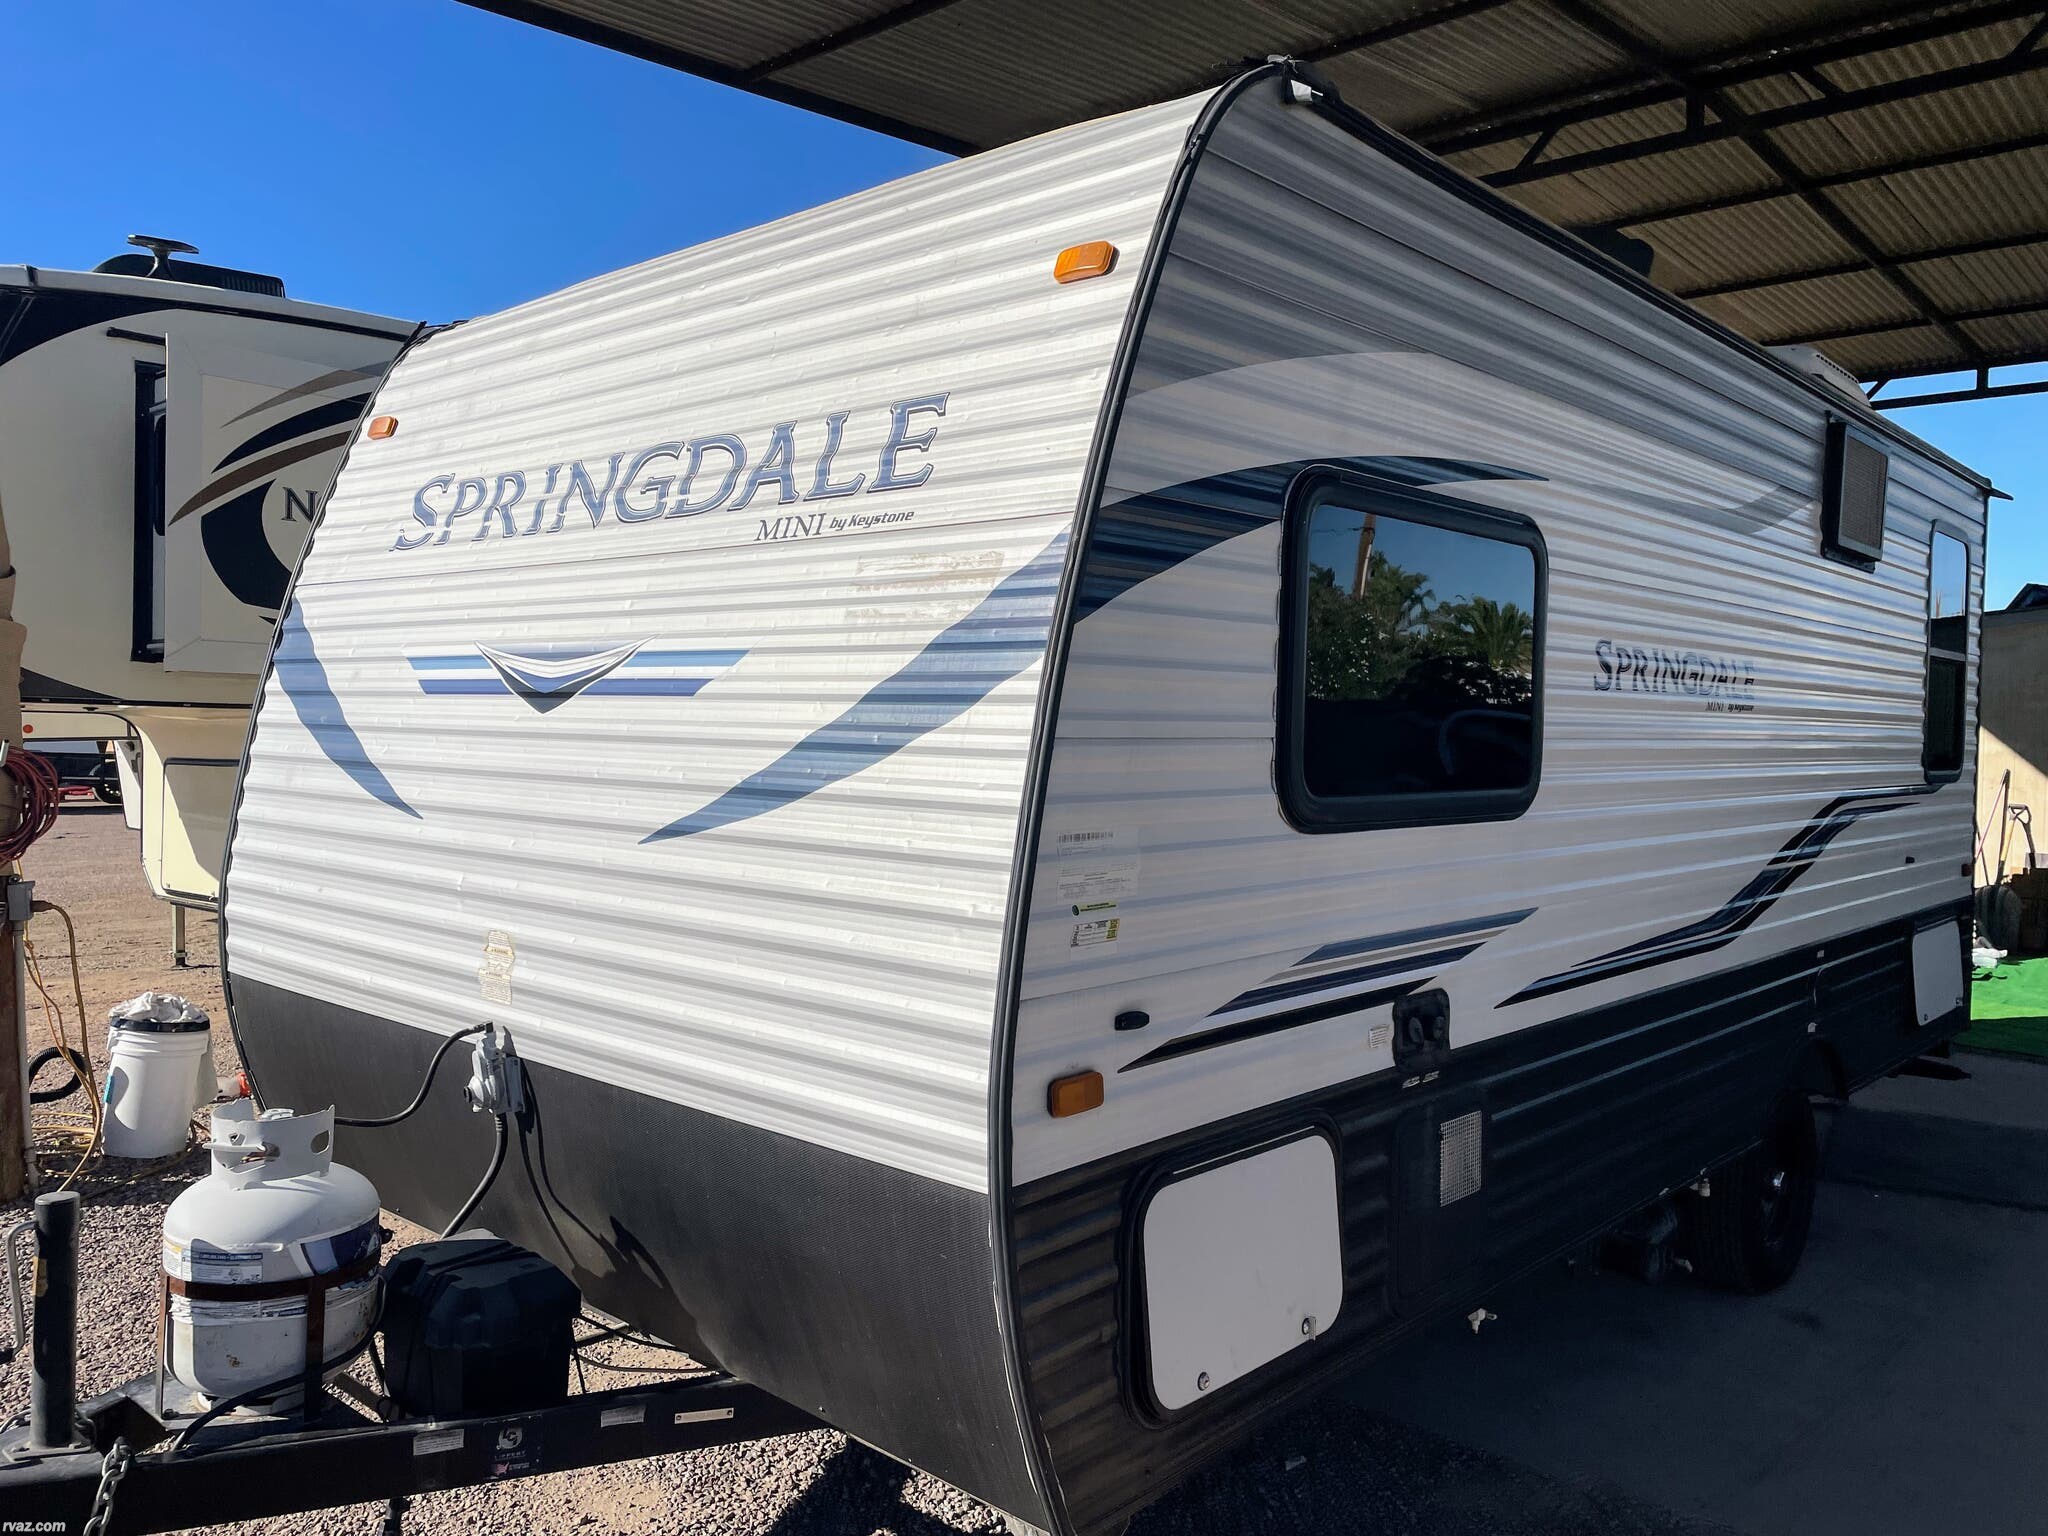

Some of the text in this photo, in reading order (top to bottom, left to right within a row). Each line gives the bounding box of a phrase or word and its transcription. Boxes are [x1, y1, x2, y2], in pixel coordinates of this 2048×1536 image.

[389, 392, 951, 552] SPRINGDALE
[754, 511, 915, 541] MINI by Keystone
[1594, 640, 1755, 699] SPRINGDALE
